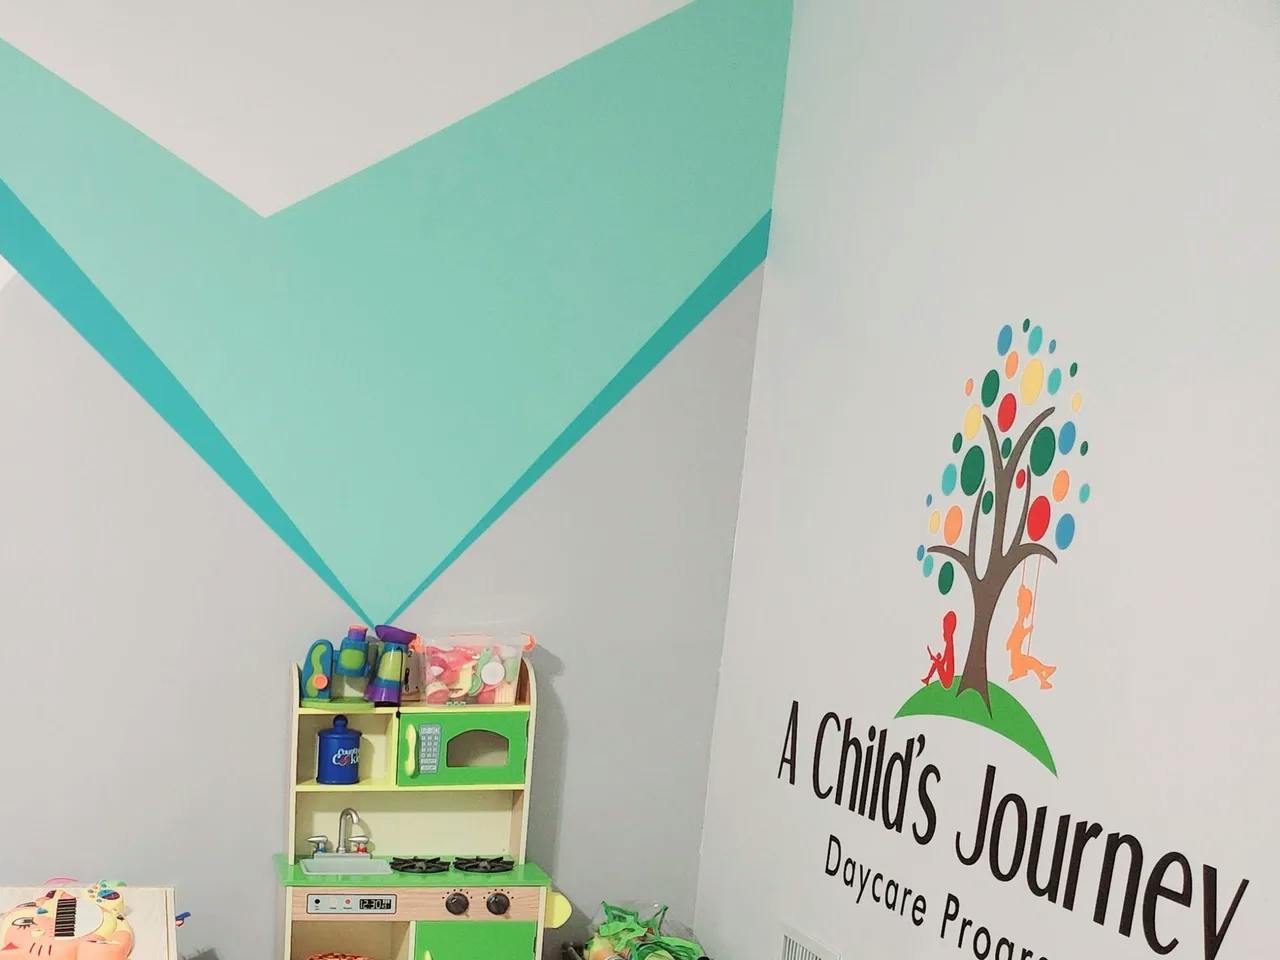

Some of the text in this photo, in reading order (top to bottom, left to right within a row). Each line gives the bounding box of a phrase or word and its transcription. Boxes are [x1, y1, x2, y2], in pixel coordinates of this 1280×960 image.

[778, 701, 798, 785] A
[812, 711, 941, 846] Child's
[825, 834, 927, 927] Daycare
